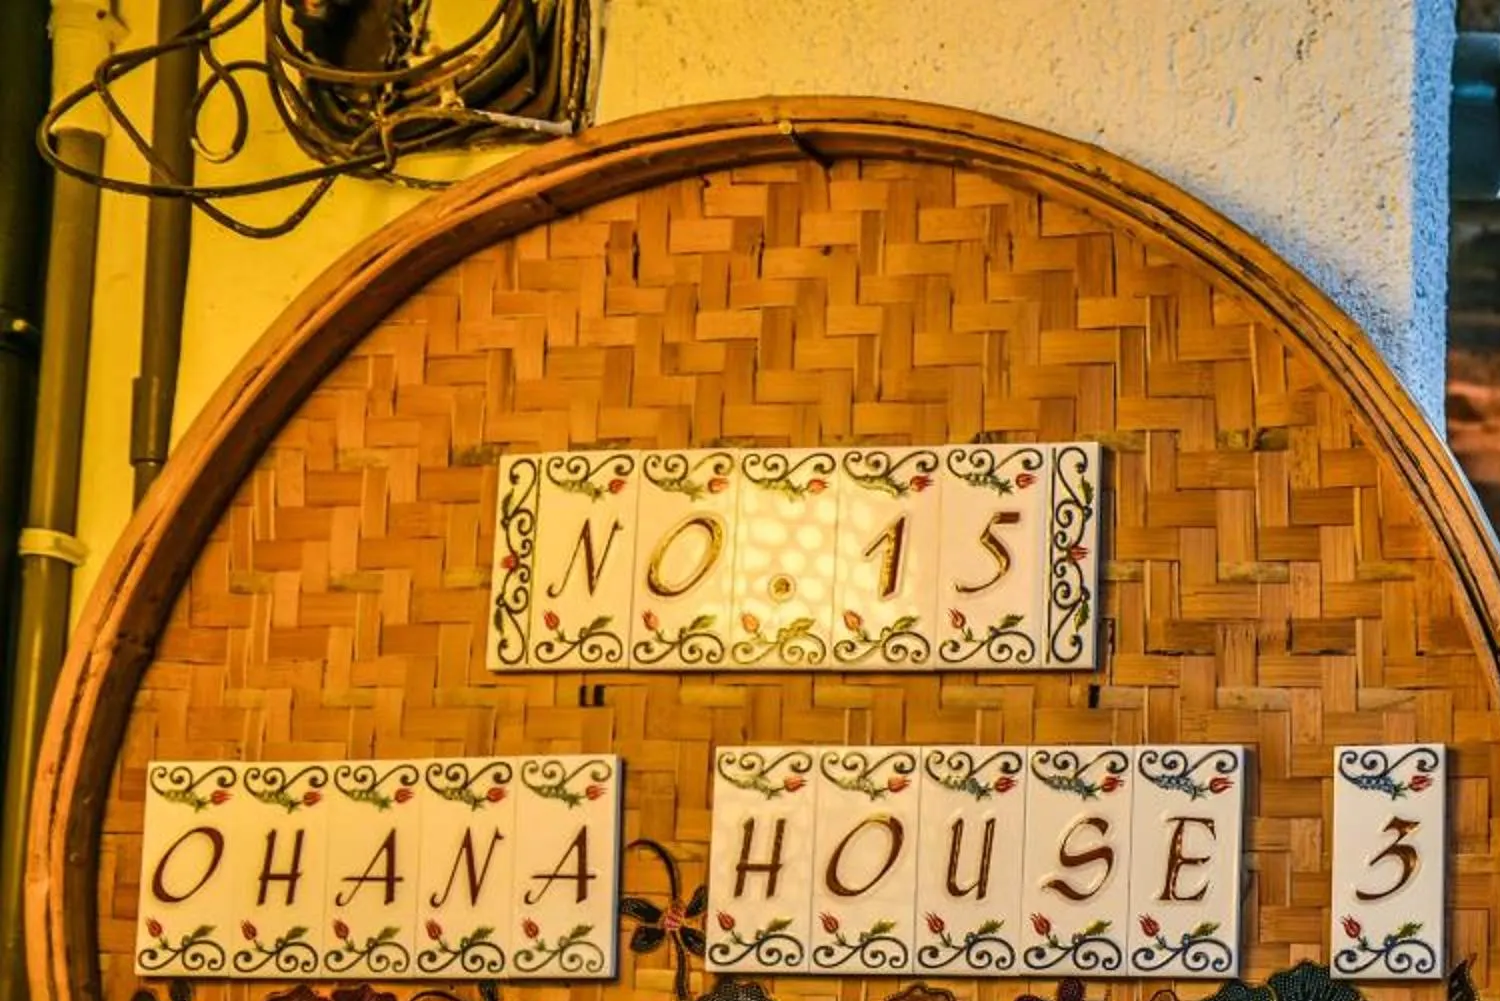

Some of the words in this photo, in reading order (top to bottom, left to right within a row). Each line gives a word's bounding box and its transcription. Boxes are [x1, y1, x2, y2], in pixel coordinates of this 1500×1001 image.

[151, 824, 597, 907] OHANA
[733, 813, 1217, 903] HOUSE
[1355, 815, 1422, 902] 3
